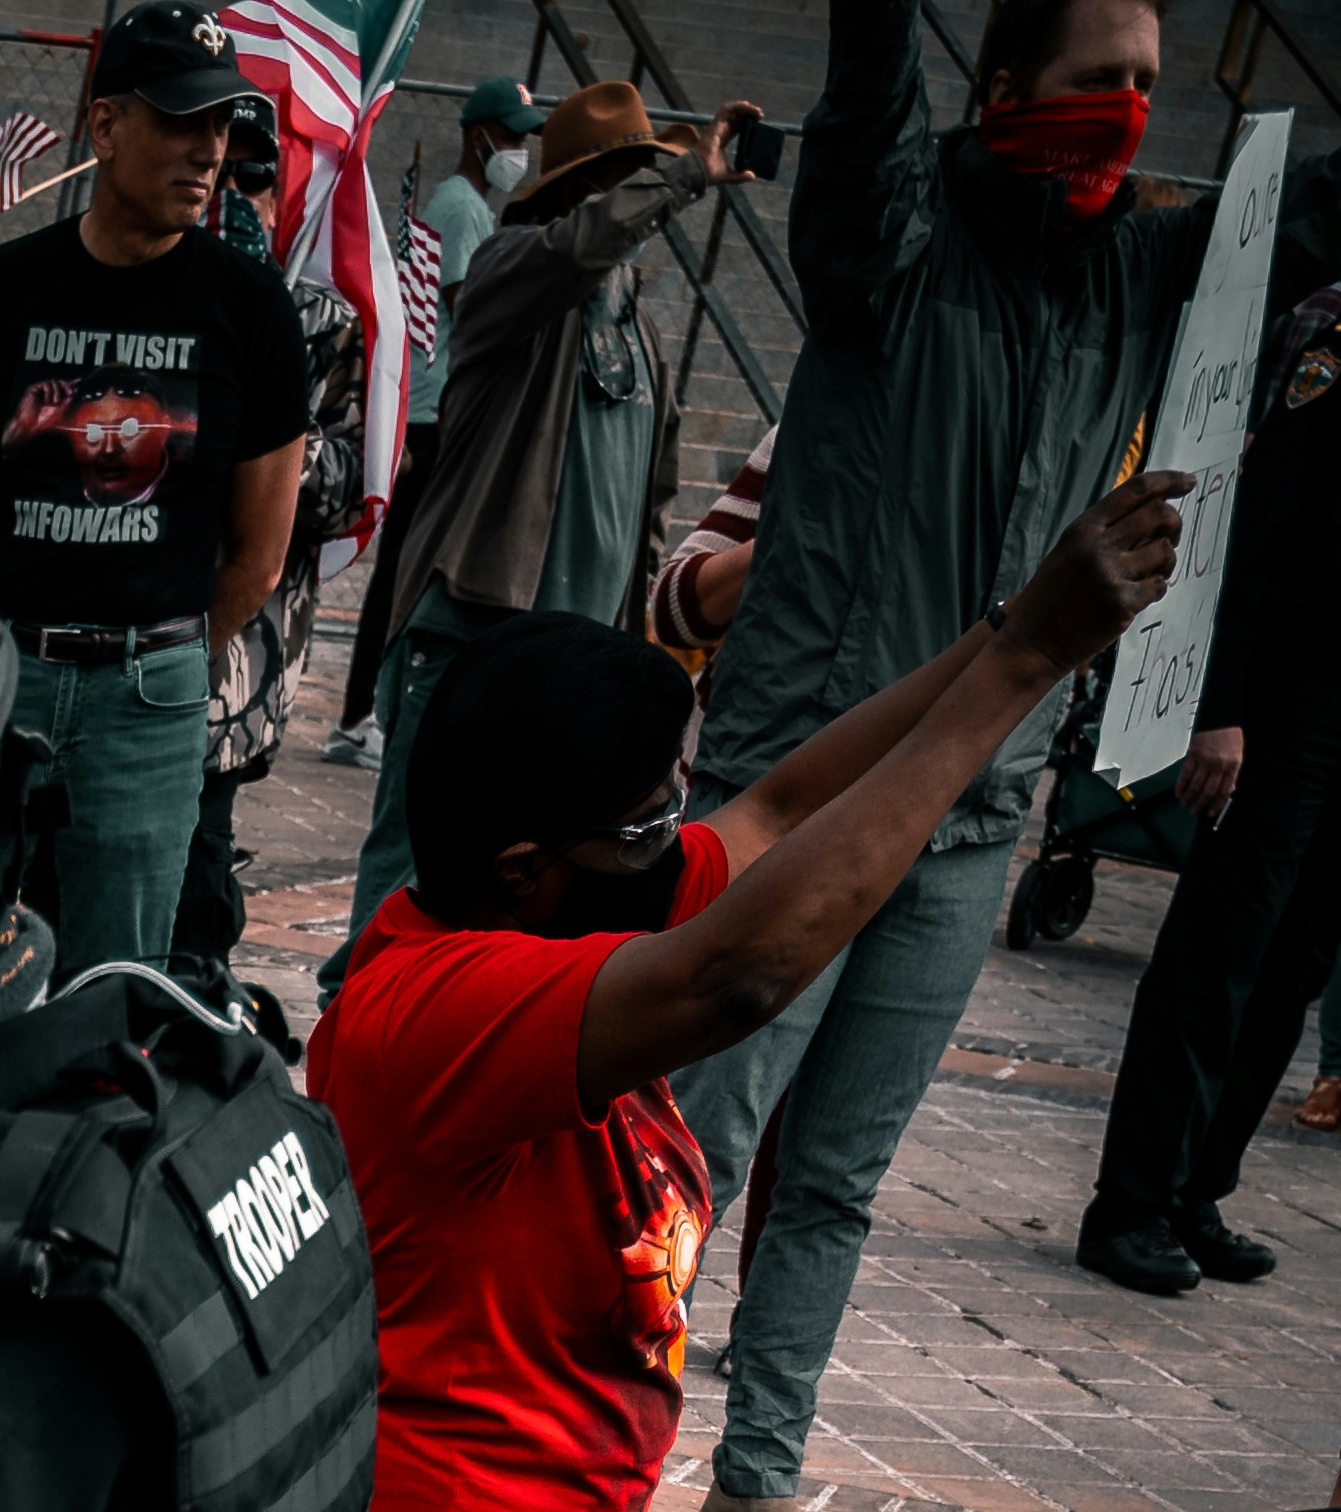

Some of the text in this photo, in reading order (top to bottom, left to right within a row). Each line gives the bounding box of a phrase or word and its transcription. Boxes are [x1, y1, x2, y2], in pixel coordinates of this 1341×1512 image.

[25, 326, 197, 370] DON'T VISIT
[13, 500, 160, 544] INFOWARS
[208, 1130, 330, 1300] TROOPER
